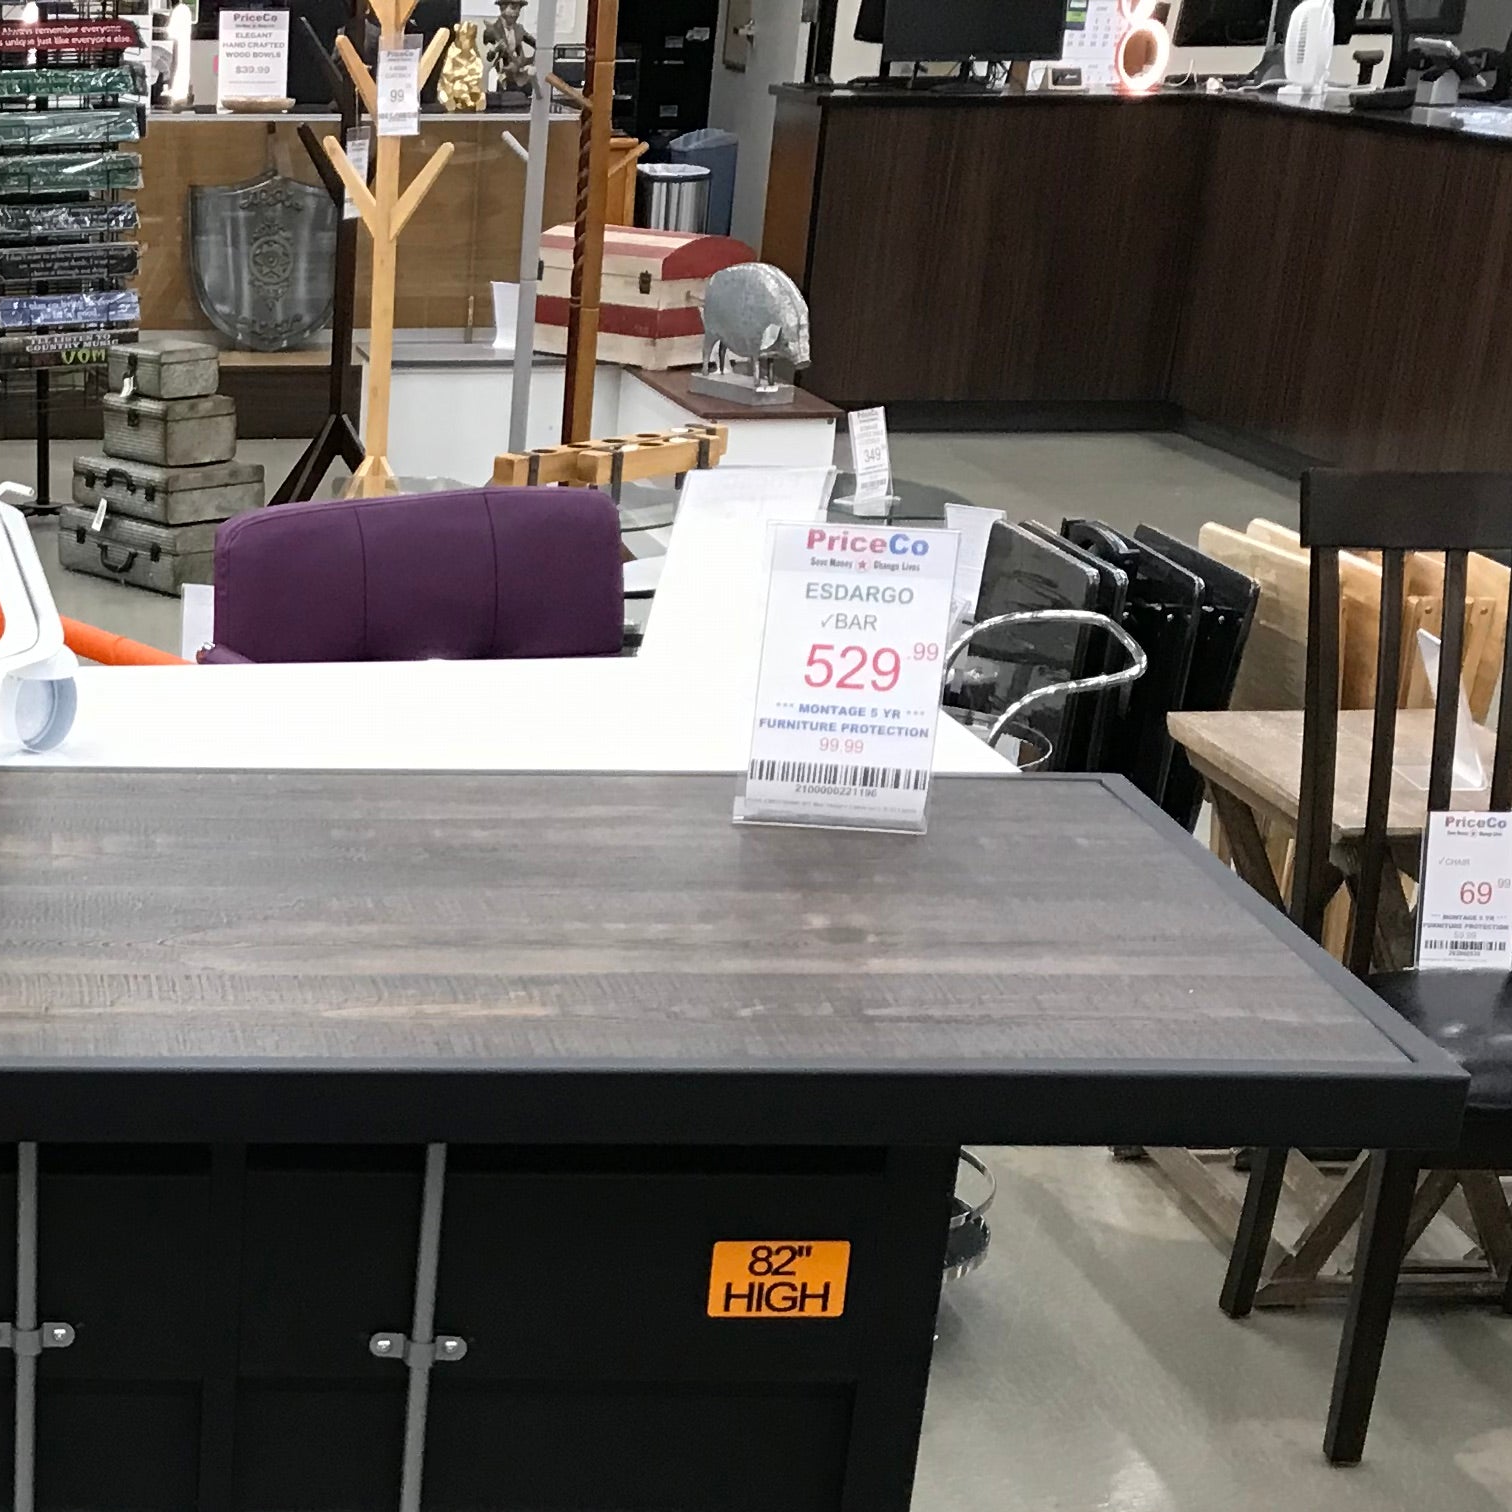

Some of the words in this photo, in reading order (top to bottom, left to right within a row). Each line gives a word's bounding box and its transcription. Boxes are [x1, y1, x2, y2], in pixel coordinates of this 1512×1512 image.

[233, 13, 278, 22] PriceCo
[35, 25, 79, 35] remember
[235, 31, 273, 39] ELEGANT
[4, 38, 35, 47] unique
[37, 37, 52, 46] just
[54, 36, 70, 44] like
[390, 88, 405, 103] 99
[26, 342, 80, 352] COUNTRY
[83, 339, 119, 347] MUSIC
[863, 447, 881, 463] 349
[806, 528, 930, 556] PriceCo
[829, 557, 853, 570] Money
[873, 559, 900, 572] Change
[901, 561, 921, 572] Lives
[805, 581, 915, 605] ESDARGO
[803, 643, 902, 692] 529
[798, 703, 867, 717] MONTAGE
[883, 708, 901, 719] YR
[759, 718, 837, 732] FURNITURE
[840, 724, 930, 738] PROTECTION
[819, 736, 865, 754] 99.99
[1444, 816, 1508, 829] PriceCo
[1445, 858, 1471, 866] CHAIR
[1460, 880, 1493, 905] 69
[748, 1245, 813, 1276] 82"
[723, 1281, 831, 1313] HIGH
